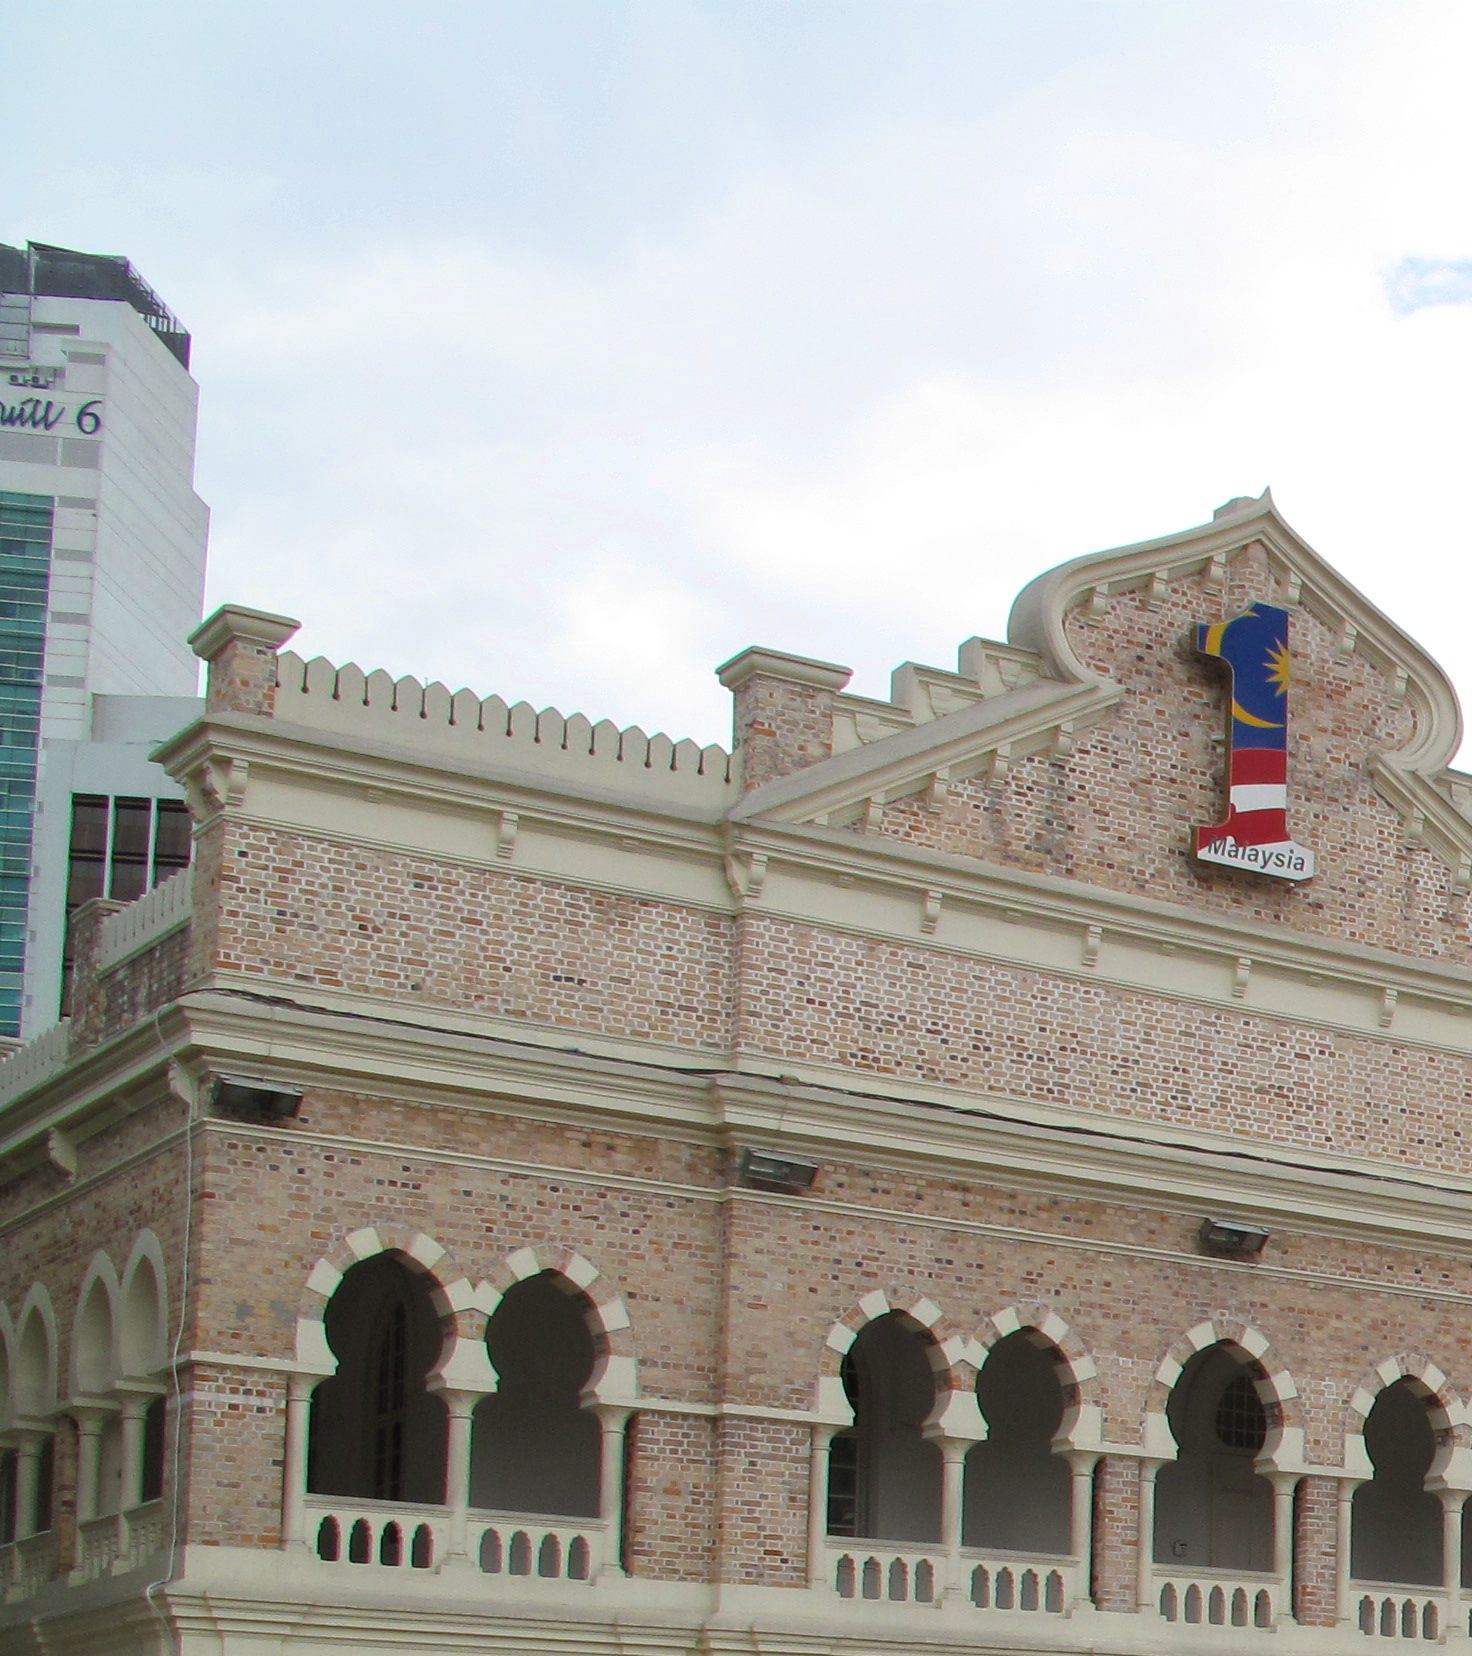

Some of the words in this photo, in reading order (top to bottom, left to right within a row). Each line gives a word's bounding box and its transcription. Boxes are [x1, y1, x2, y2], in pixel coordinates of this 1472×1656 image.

[0, 397, 65, 431] uill
[76, 399, 103, 435] 6
[1207, 835, 1306, 872] Malaysia
